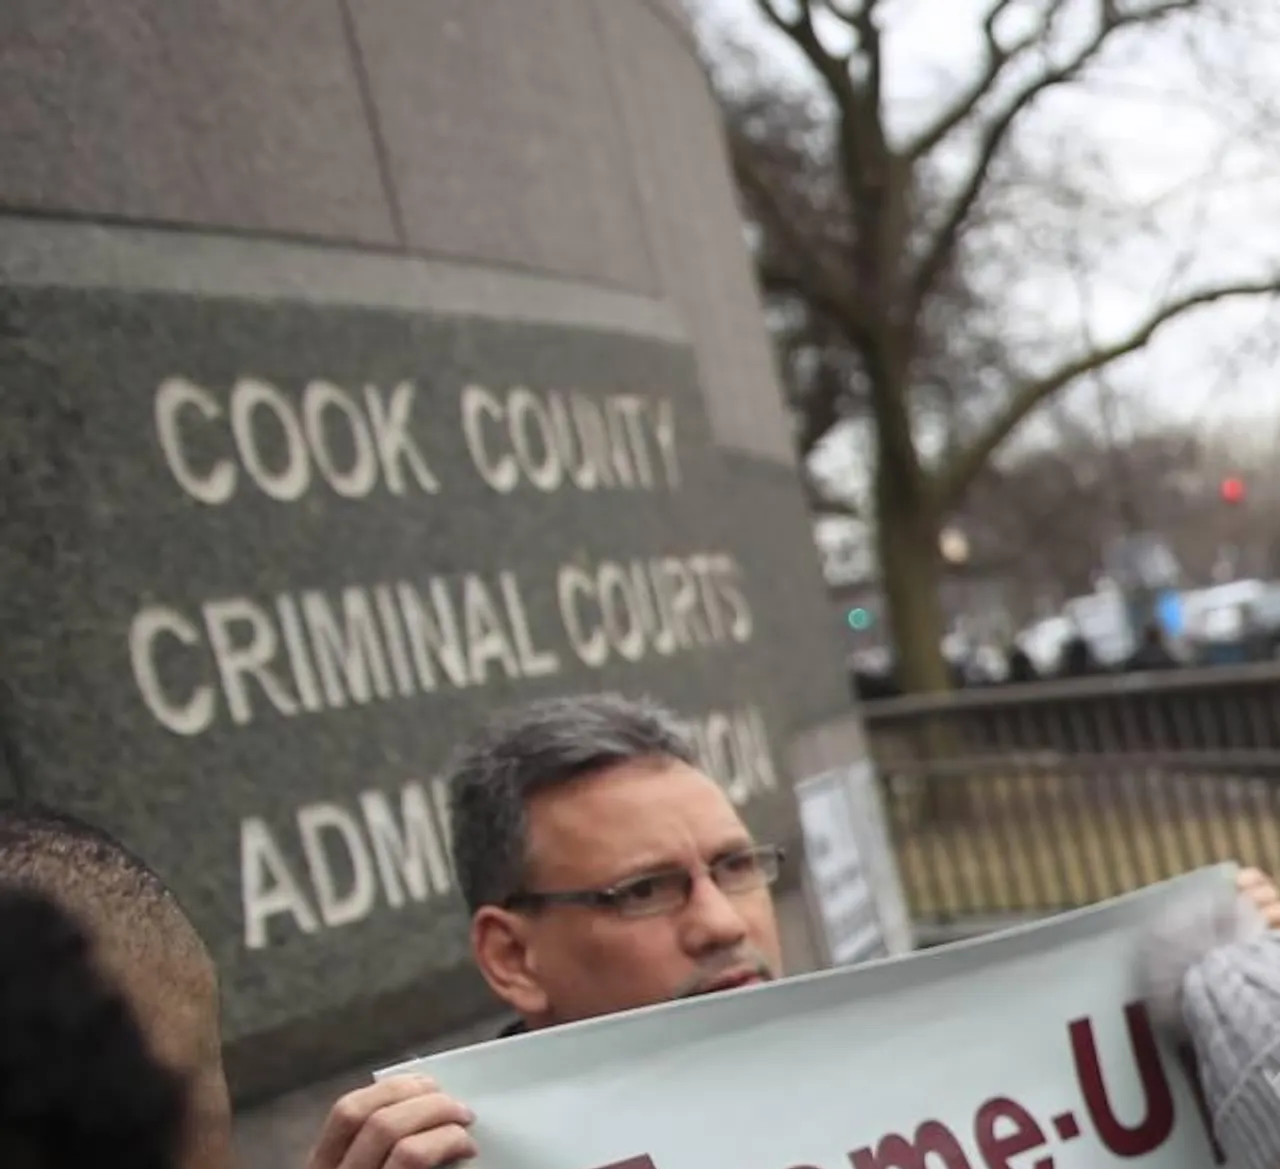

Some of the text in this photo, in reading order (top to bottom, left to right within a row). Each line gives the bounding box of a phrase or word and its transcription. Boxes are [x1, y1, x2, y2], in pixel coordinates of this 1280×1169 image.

[154, 375, 684, 504] COOK COUNTY
[129, 552, 753, 736] CRIMINAL COURTS
